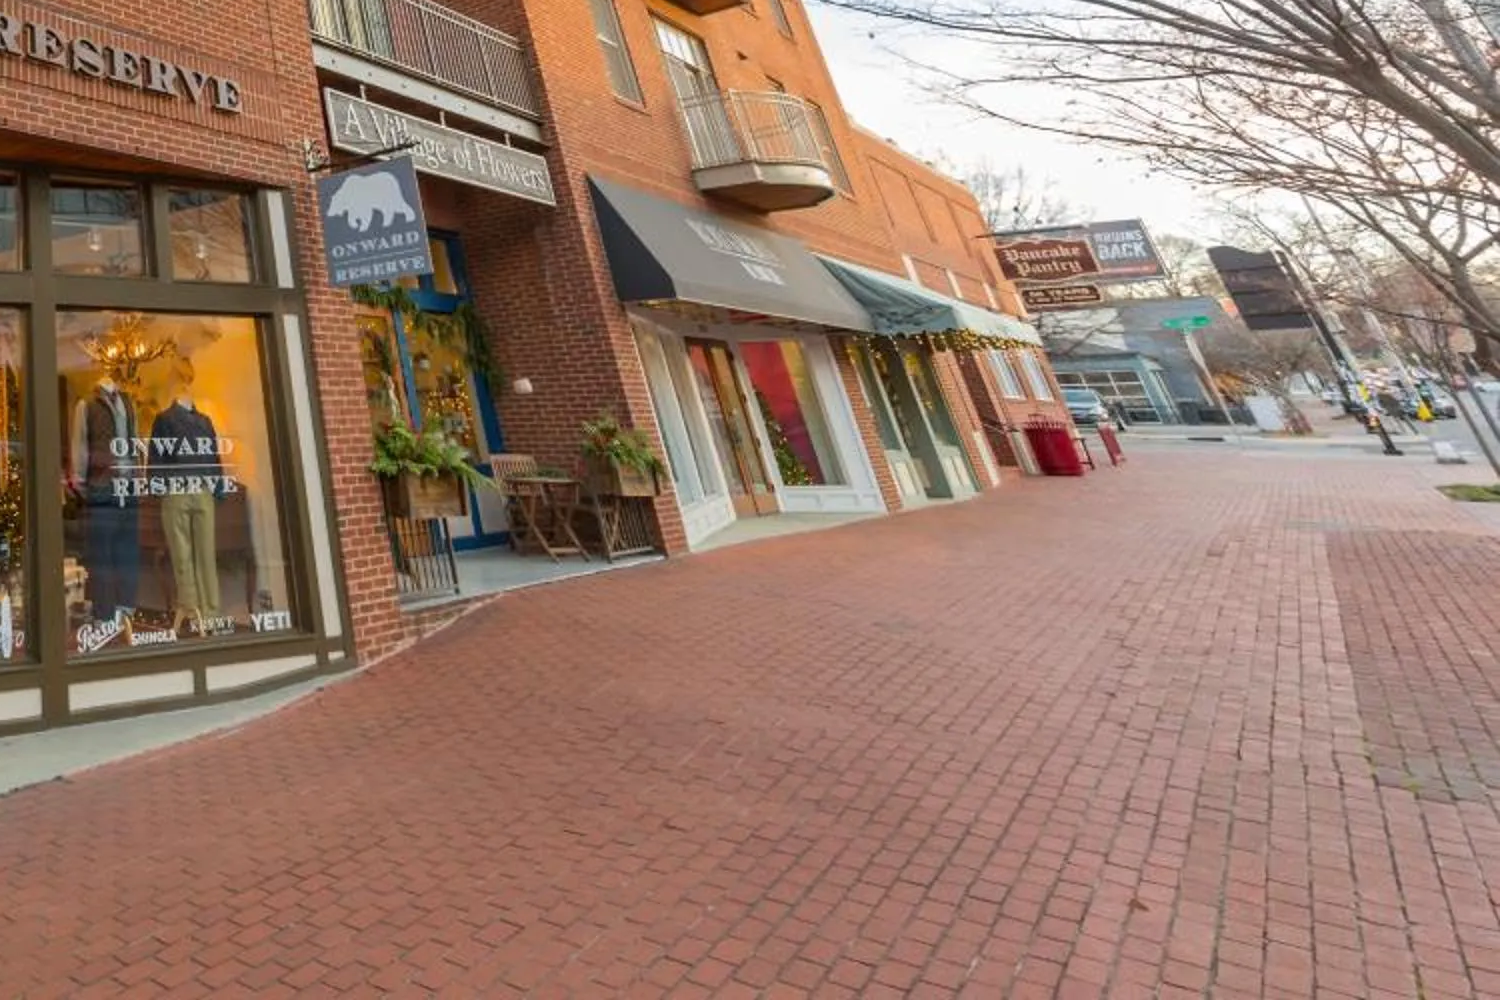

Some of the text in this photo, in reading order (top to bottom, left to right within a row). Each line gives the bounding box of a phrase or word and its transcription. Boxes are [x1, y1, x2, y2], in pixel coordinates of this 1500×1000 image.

[345, 103, 547, 190] A Village of Flowers
[332, 231, 419, 257] ONWARD
[1003, 245, 1081, 263] Pancake
[1098, 242, 1147, 260] BACK
[336, 256, 425, 282] RESERVE
[1015, 261, 1083, 277] Pantry
[110, 437, 235, 457] ONWARD
[112, 475, 238, 496] RESERVE
[77, 607, 128, 652] Persol
[250, 611, 292, 632] YETI
[130, 629, 177, 646] SHINOLA
